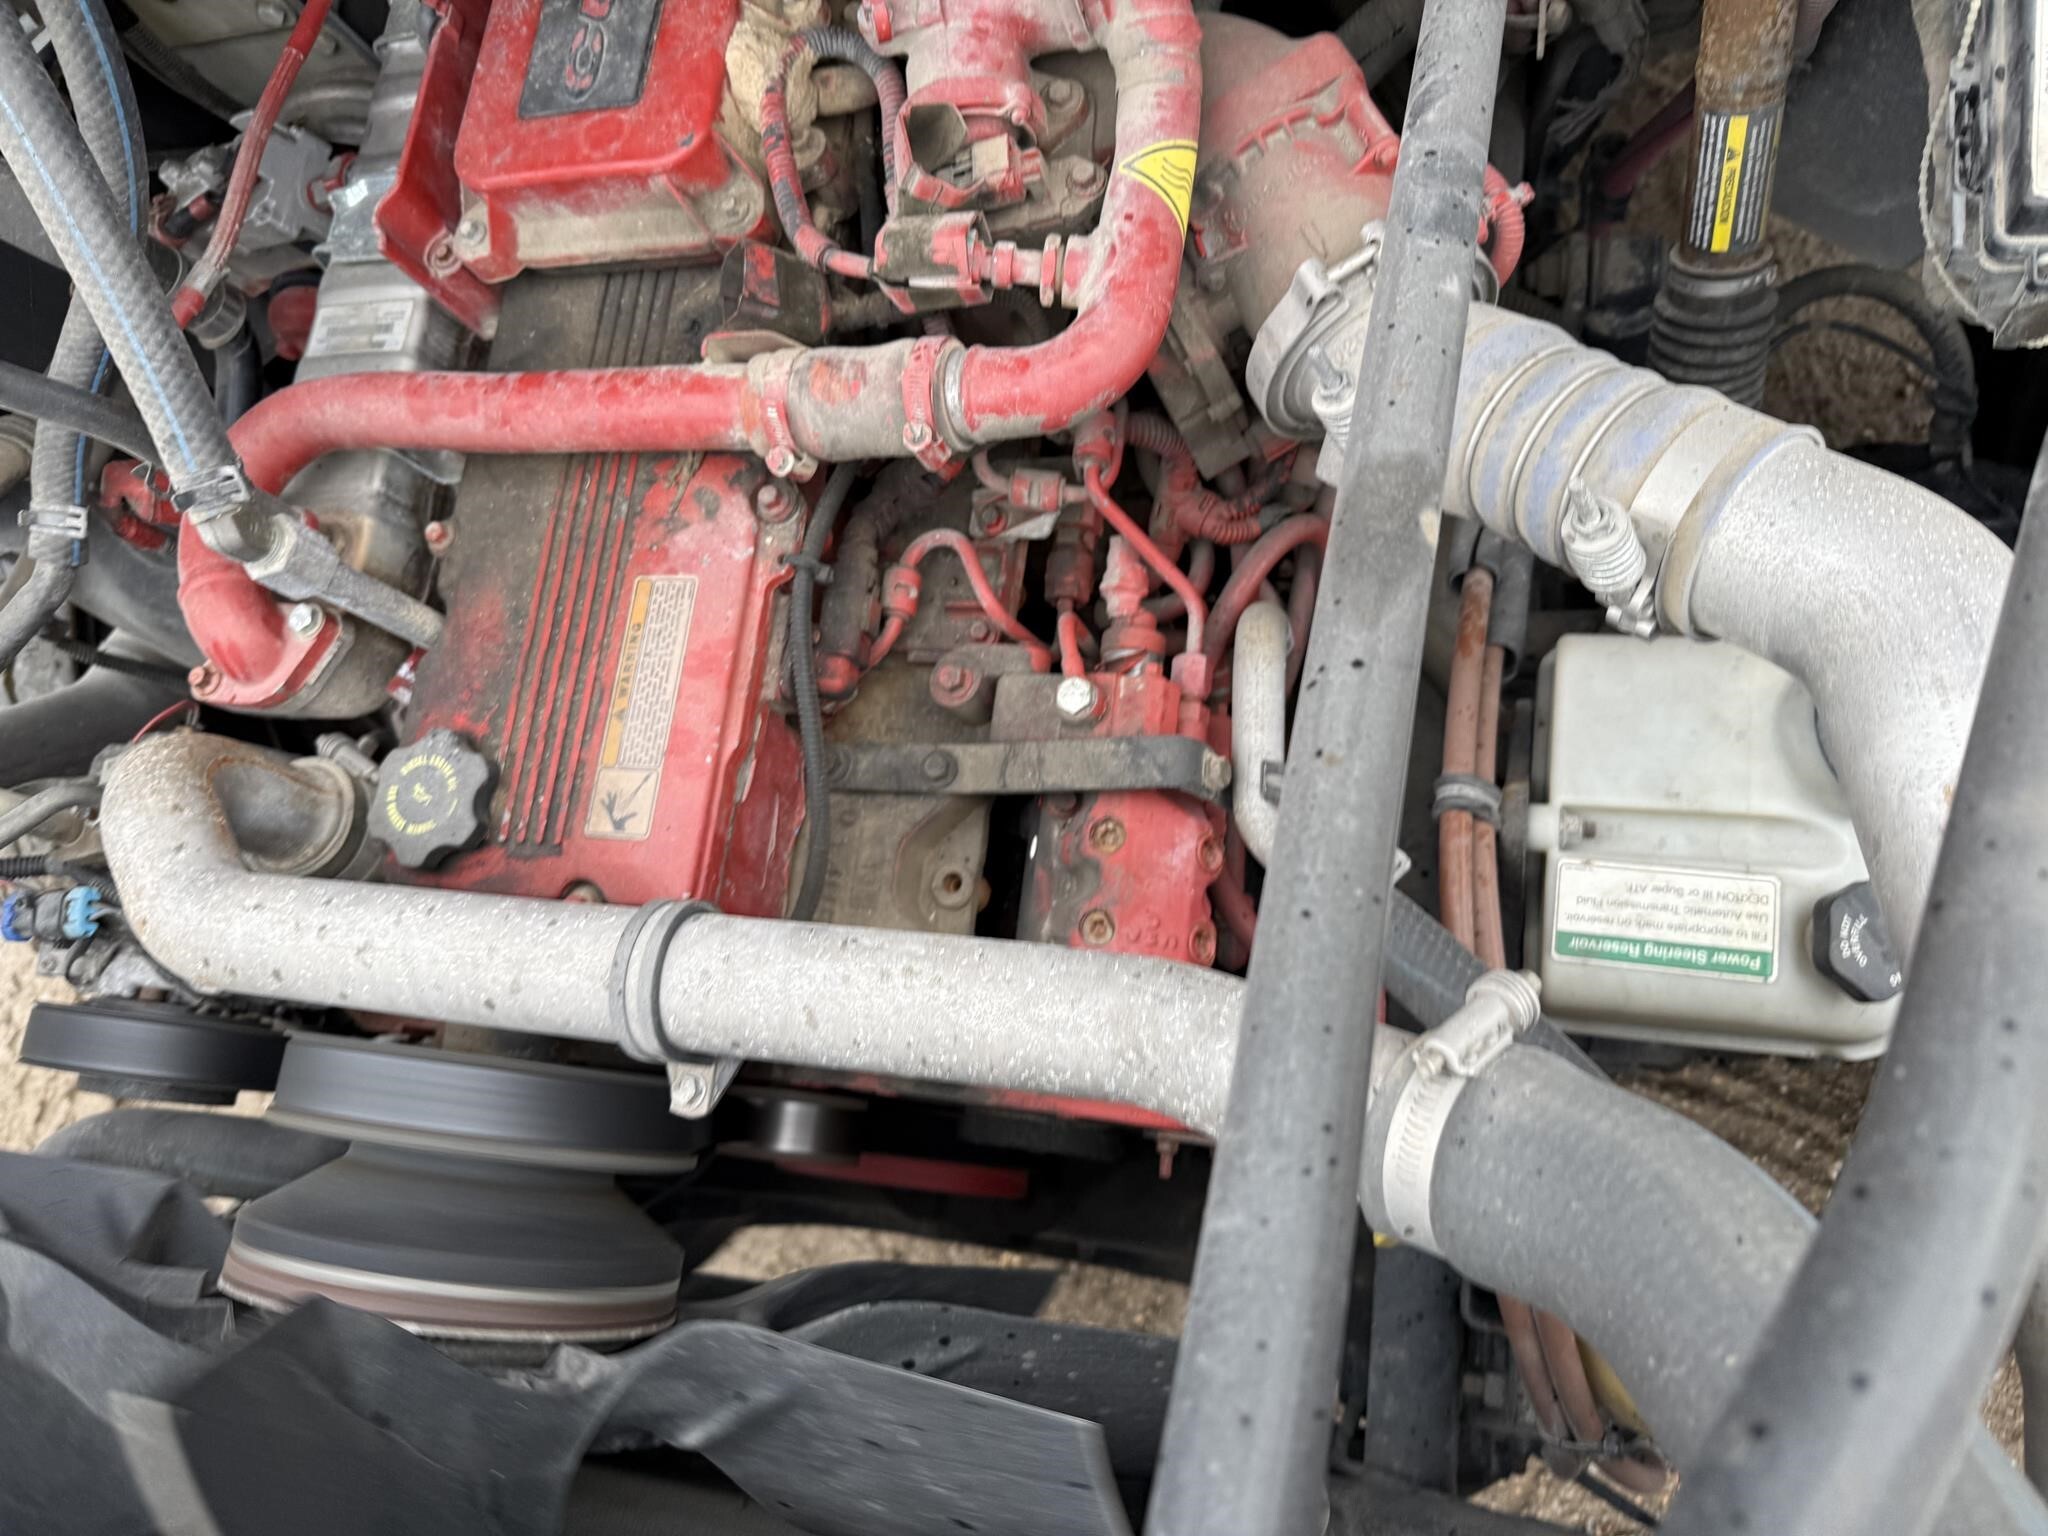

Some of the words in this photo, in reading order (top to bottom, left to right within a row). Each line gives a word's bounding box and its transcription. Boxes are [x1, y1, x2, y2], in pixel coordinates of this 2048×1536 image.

[619, 623, 642, 697] WARNING
[1651, 884, 1684, 898] Super
[1688, 888, 1700, 897] or
[1576, 896, 1603, 909] Fluid
[1607, 898, 1680, 915] Transmission
[1683, 906, 1742, 921] Automatic
[1746, 911, 1769, 923] Use
[1617, 917, 1633, 928] on
[1636, 917, 1663, 930] mark
[1667, 921, 1733, 936] appropriate
[1737, 929, 1748, 938] to
[1752, 930, 1768, 943] Fill
[1569, 936, 1640, 958] Reservoir
[1644, 941, 1708, 965] Steering
[1711, 952, 1761, 970] Power
